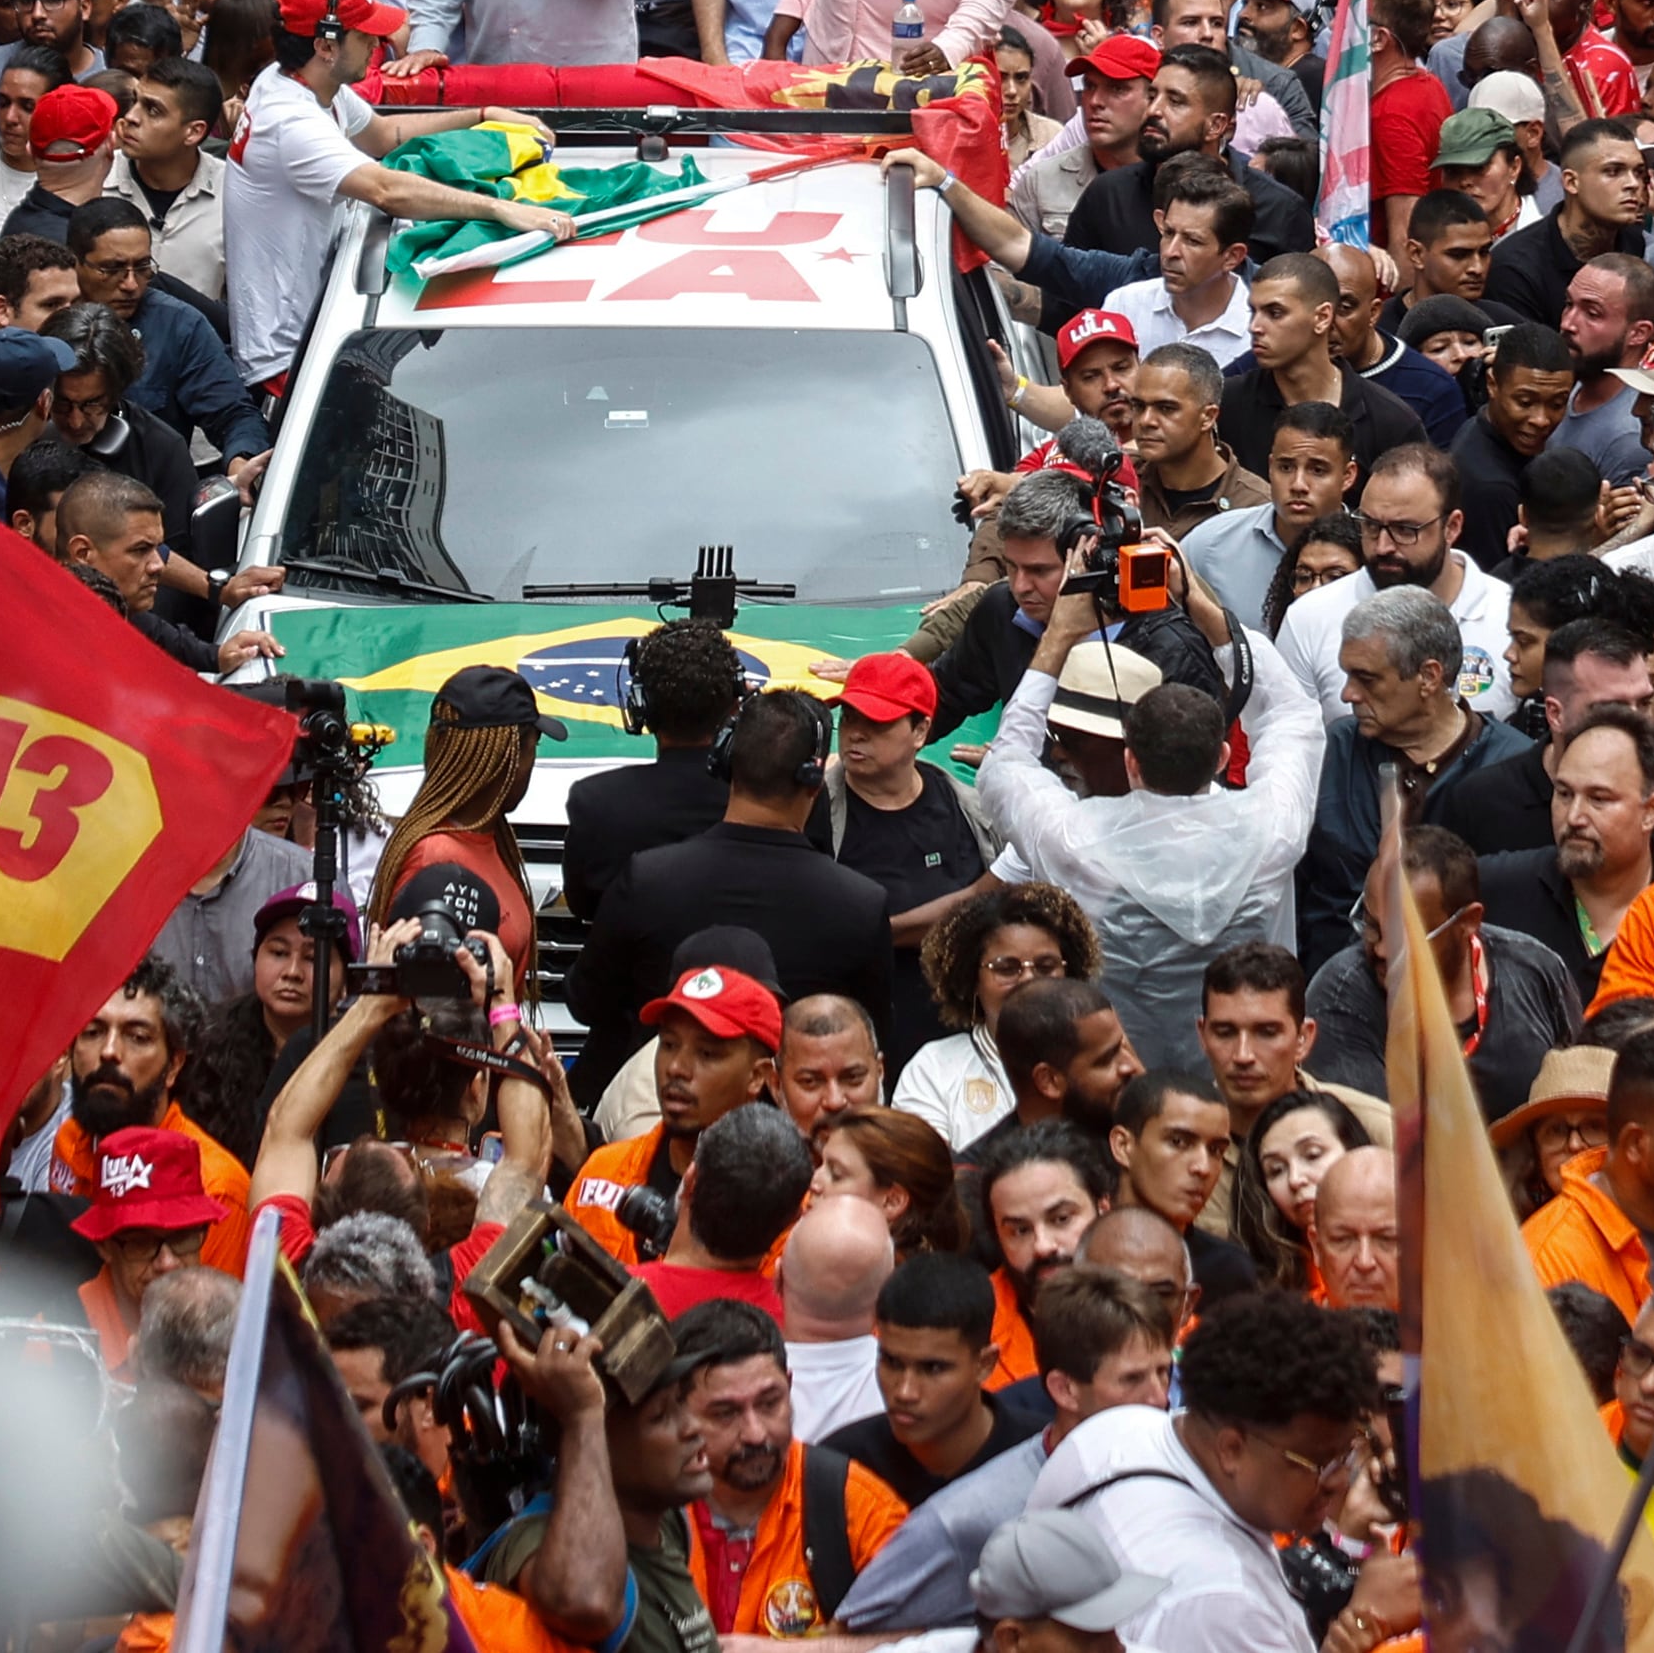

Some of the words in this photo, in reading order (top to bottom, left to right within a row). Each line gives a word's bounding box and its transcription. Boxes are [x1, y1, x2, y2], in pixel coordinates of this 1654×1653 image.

[1069, 318, 1117, 344] LULA
[1240, 642, 1251, 686] Canon
[444, 880, 481, 901] AYR
[443, 894, 479, 914] TON
